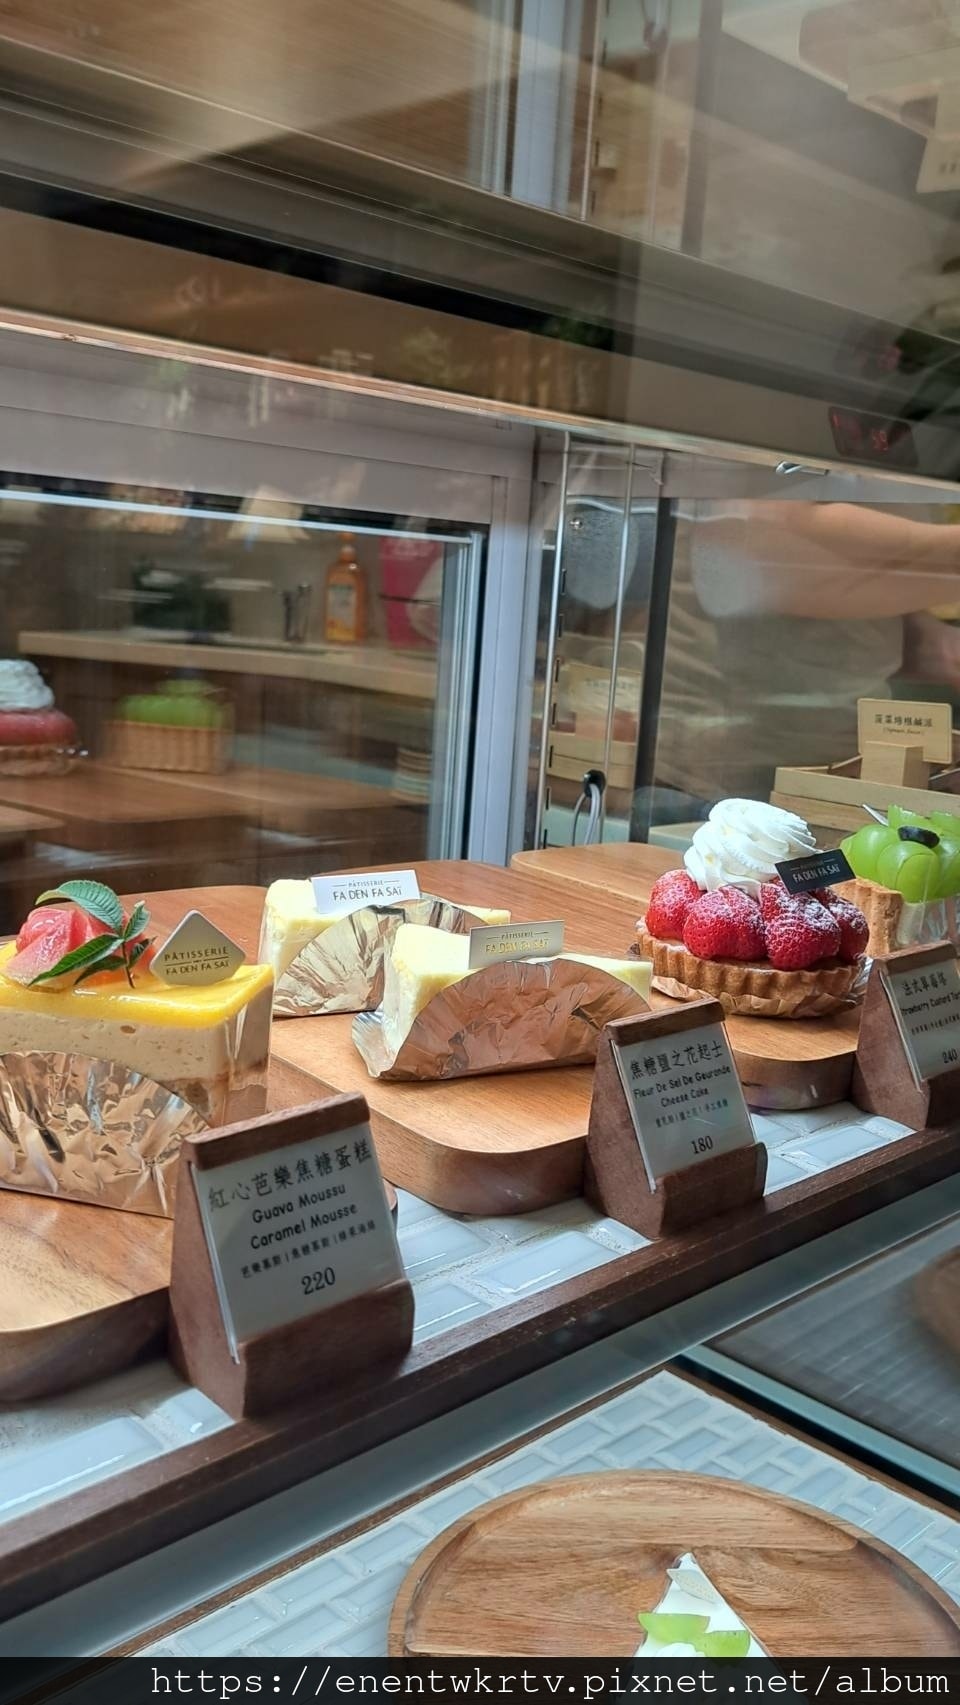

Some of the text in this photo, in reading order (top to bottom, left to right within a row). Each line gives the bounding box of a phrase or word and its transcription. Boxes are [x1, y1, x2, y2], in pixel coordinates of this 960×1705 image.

[333, 891, 347, 901] FA
[348, 888, 369, 900] DEN
[372, 888, 385, 897] FA
[166, 967, 178, 975] FA
[180, 964, 198, 974] DEN
[201, 962, 212, 971] FA
[633, 1087, 655, 1100] Fleur
[656, 1083, 667, 1093] De
[669, 1078, 682, 1089] Sel
[682, 1075, 694, 1086] De
[661, 1087, 709, 1107] Cheese Cake
[691, 1135, 713, 1154] 180
[208, 1139, 372, 1212] 紅心芭樂焦糖蛋糕
[252, 1184, 346, 1224] Guava Moussu
[250, 1203, 358, 1250] Caramel Mousse
[301, 1267, 336, 1295] 220
